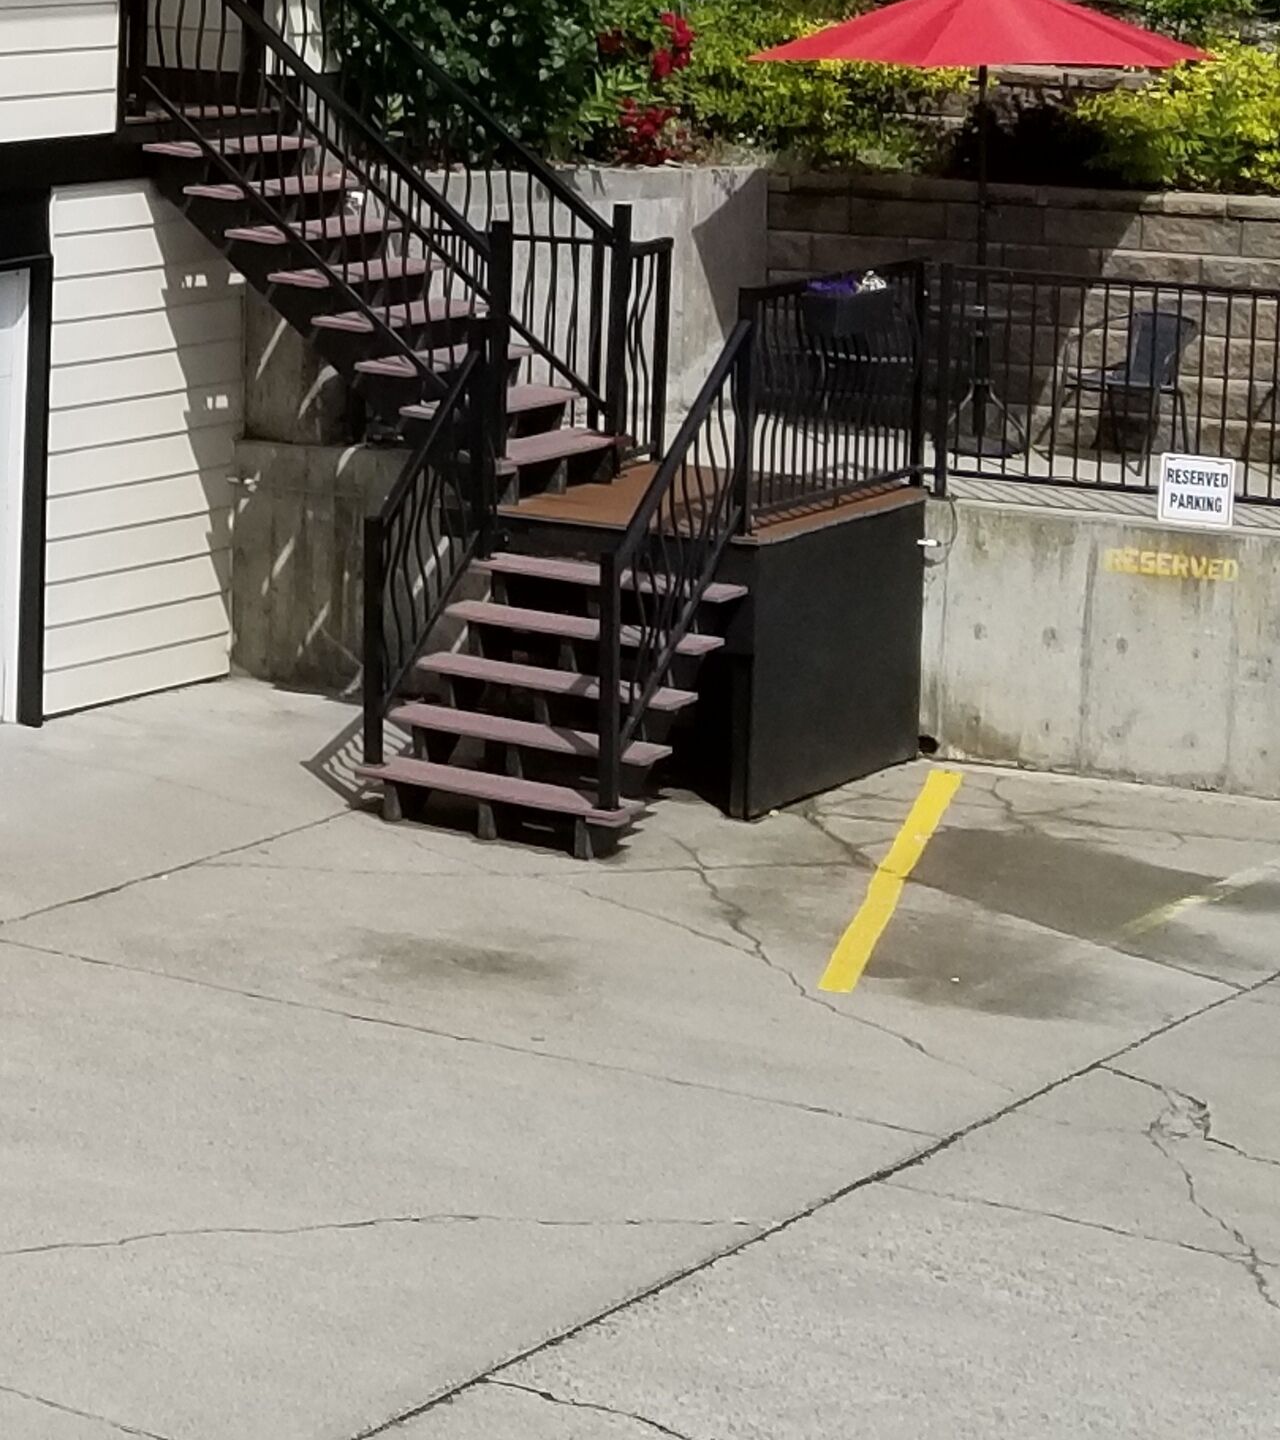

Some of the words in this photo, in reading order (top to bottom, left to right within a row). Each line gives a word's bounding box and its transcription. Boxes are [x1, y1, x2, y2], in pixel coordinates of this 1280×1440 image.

[1166, 467, 1229, 488] RESERVED
[1169, 492, 1223, 513] PARKING
[1104, 547, 1239, 580] RESERVED
